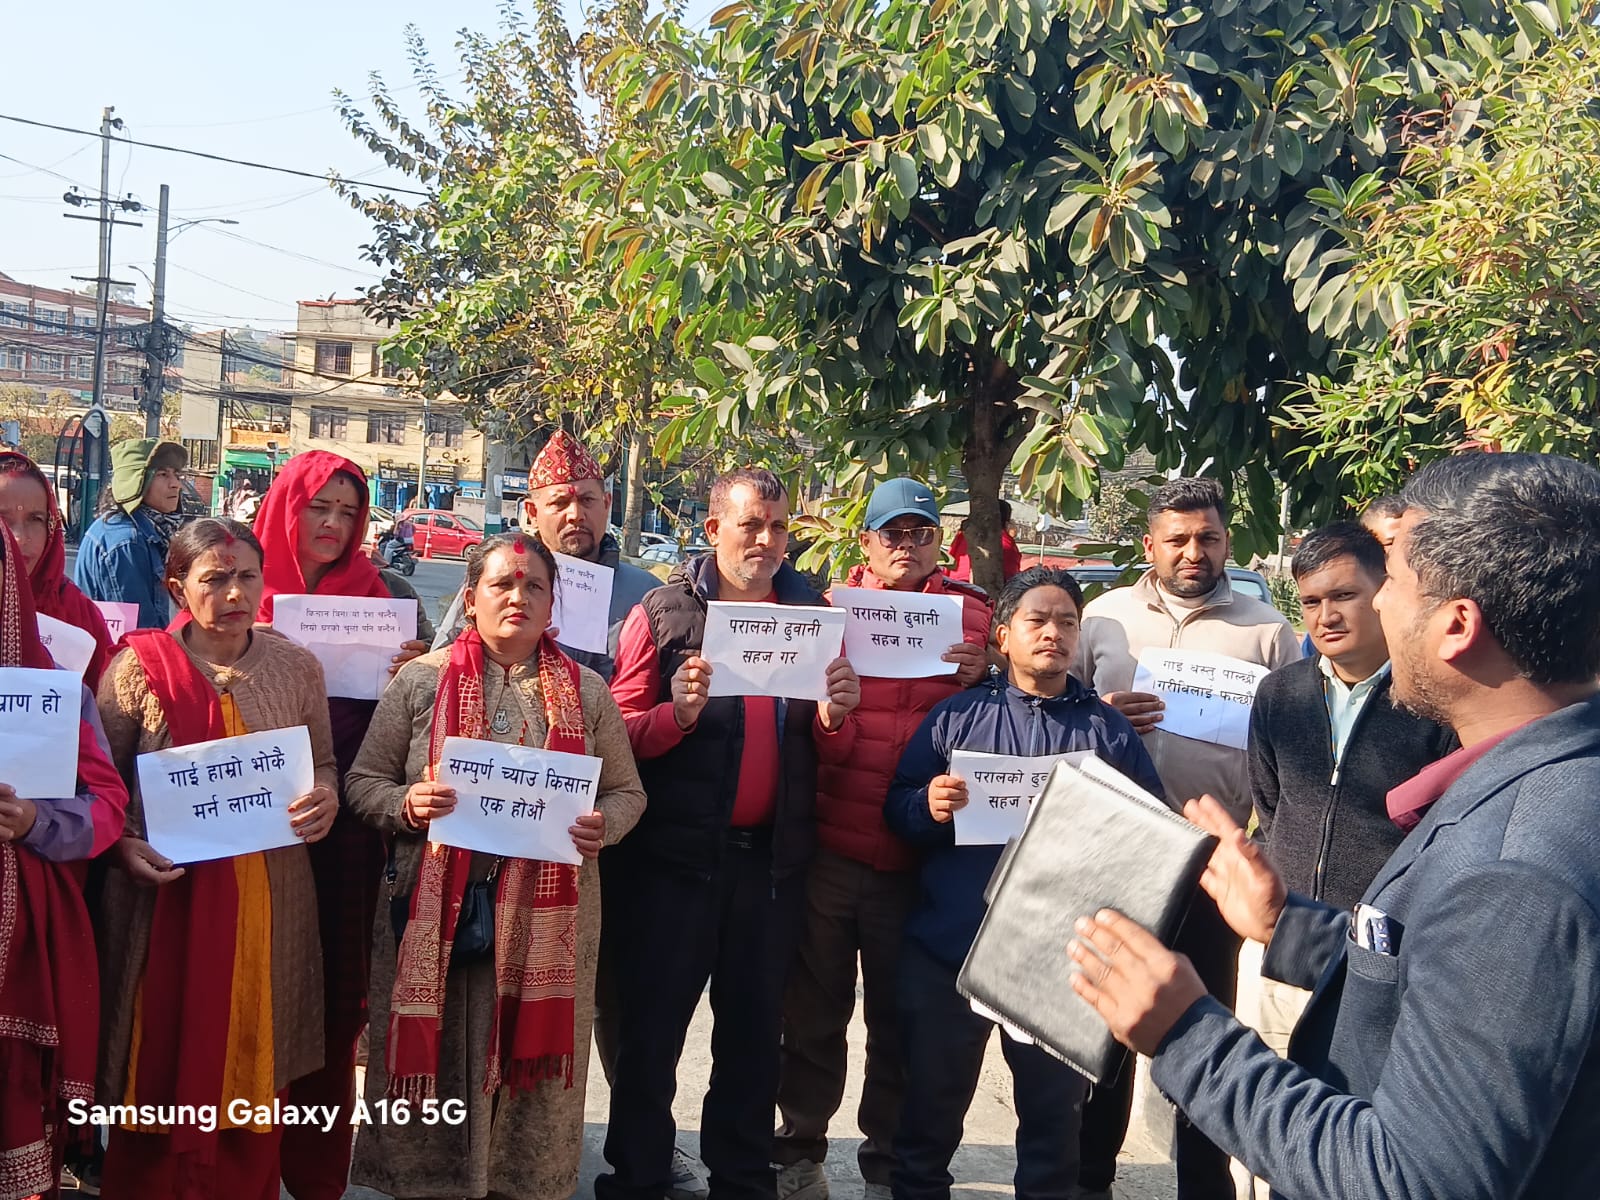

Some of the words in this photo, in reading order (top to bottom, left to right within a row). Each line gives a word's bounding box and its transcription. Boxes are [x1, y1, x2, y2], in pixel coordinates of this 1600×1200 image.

[852, 605, 897, 622] परालको
[903, 608, 940, 628] ढुवानी
[729, 616, 778, 635] परालको
[784, 618, 822, 641] ढुवानी
[871, 633, 900, 647] सहज
[906, 636, 923, 648] गर
[742, 650, 774, 664] सहज
[780, 651, 798, 664] गर
[42, 689, 61, 714] हो
[168, 761, 199, 787] गाई
[206, 755, 243, 782] हाम्रो
[251, 746, 285, 772] भोकै
[974, 769, 1024, 784] परालको
[501, 766, 539, 787] च्याउ
[545, 768, 592, 795] किसान
[193, 794, 219, 820] मर्न
[227, 787, 272, 814] लाग्यो
[480, 796, 505, 816] एक
[989, 795, 1021, 809] सहज
